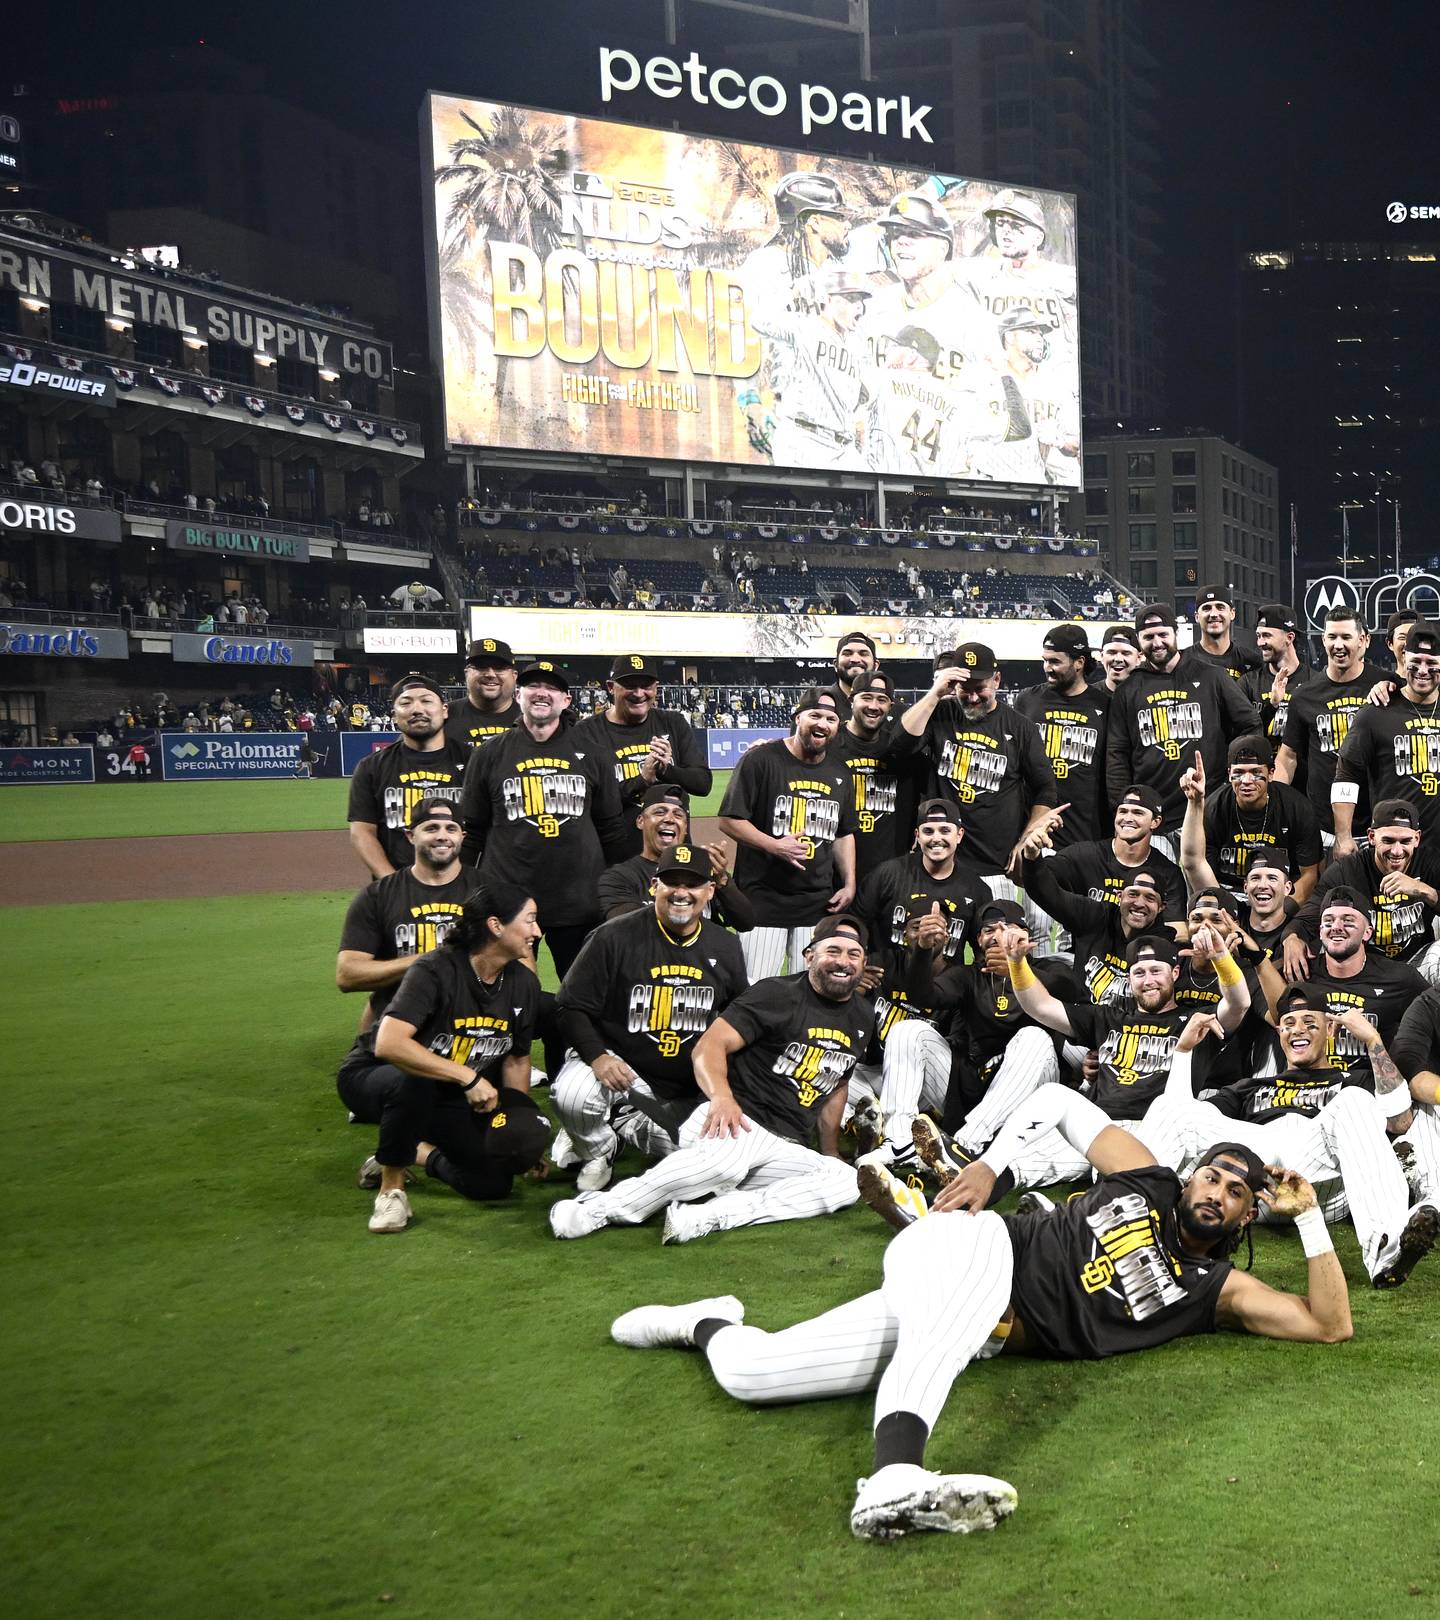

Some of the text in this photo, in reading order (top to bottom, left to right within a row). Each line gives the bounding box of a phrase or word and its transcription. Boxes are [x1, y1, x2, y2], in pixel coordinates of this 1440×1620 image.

[600, 46, 934, 143] petco park
[561, 195, 694, 249] NLDS
[488, 240, 762, 379] BOUND
[73, 268, 198, 334] METAL
[208, 306, 328, 366] SUPPLY
[343, 341, 391, 383] CO.
[562, 373, 609, 406] FIGHT
[628, 380, 701, 413] FAITHFUL
[892, 380, 958, 422] MUSGROVE
[901, 409, 944, 463] 44
[0, 501, 76, 534] ORIS
[186, 528, 299, 556] BIG BULLY TURF
[203, 637, 293, 664] Canel's
[484, 639, 496, 652] SD
[631, 655, 643, 670] SD
[965, 651, 977, 665] SD
[1146, 690, 1188, 704] PADRES
[1045, 711, 1088, 725] PADRES
[1138, 702, 1203, 747] CLINCHED
[204, 741, 300, 759] Palomar
[955, 732, 998, 749] PADRES
[1164, 739, 1180, 760] SD
[175, 761, 235, 770] SPECIALTY
[516, 758, 571, 773] PADRES
[938, 738, 1008, 793] CLINCHED
[1053, 758, 1069, 779] SD
[400, 770, 452, 783] PADRES
[789, 780, 832, 794] PADRES
[1421, 772, 1438, 796] SD
[503, 774, 587, 822] CLINCHED
[958, 783, 976, 804] SD
[538, 813, 560, 838] SD
[772, 795, 841, 840] CLINCHED
[859, 811, 875, 833] SD
[1234, 832, 1276, 845] PADRES
[676, 846, 691, 863] SD
[411, 903, 464, 918] PADRES
[650, 965, 703, 979] PADRES
[1175, 990, 1221, 1004] PADRES
[628, 983, 715, 1034] CLINCHED
[454, 1016, 508, 1031] PADRES
[659, 1030, 680, 1057] SD
[1117, 1068, 1139, 1086] SD
[799, 1081, 821, 1108] SD
[1080, 1255, 1115, 1294] SD
